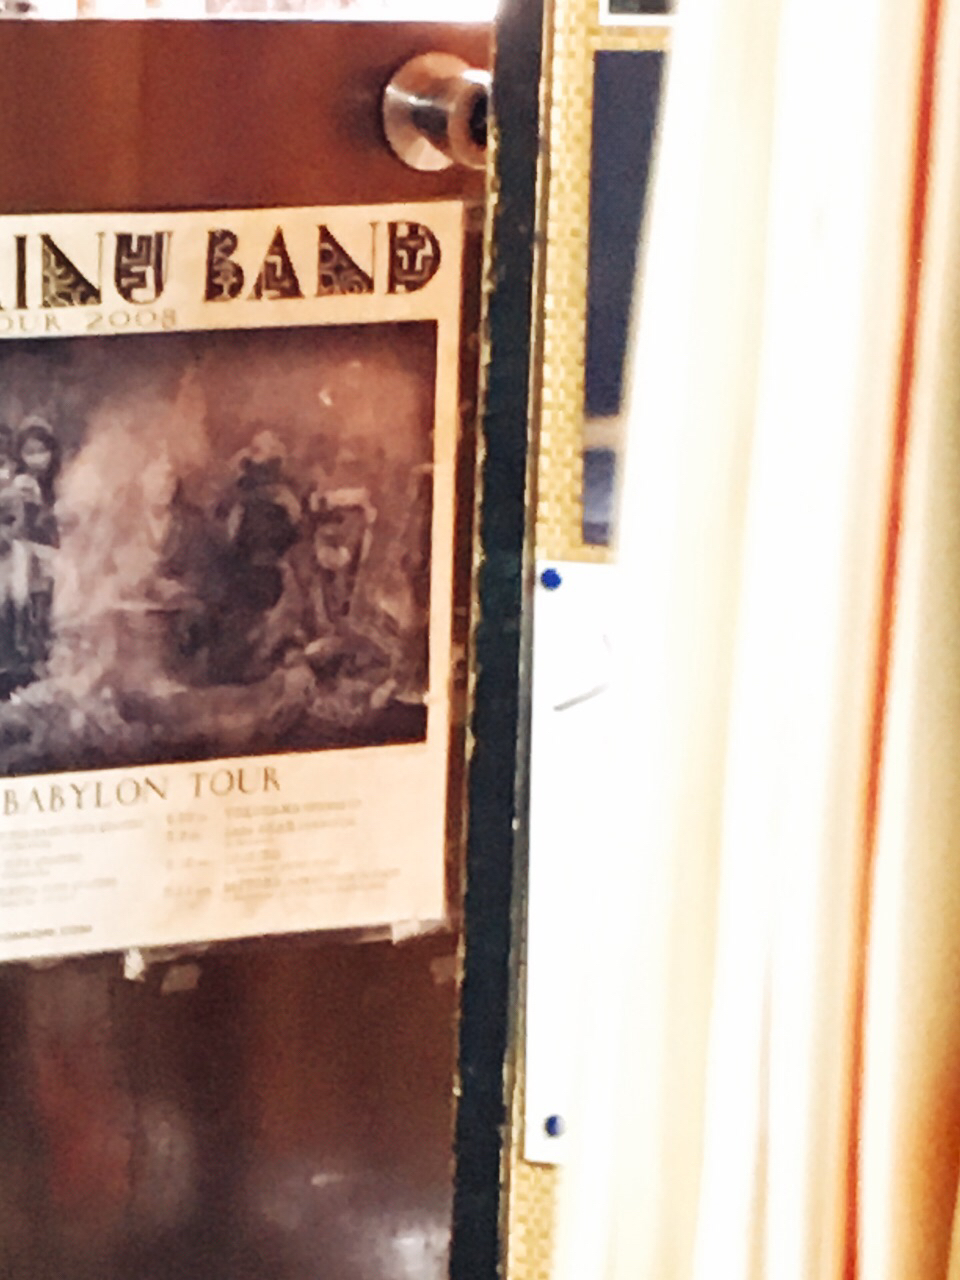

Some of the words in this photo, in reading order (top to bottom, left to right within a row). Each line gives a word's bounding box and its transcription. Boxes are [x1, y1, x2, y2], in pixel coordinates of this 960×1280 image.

[203, 220, 442, 302] BAND
[86, 308, 177, 332] 2008
[3, 775, 168, 817] BABYLON
[191, 766, 281, 798] TOUR
